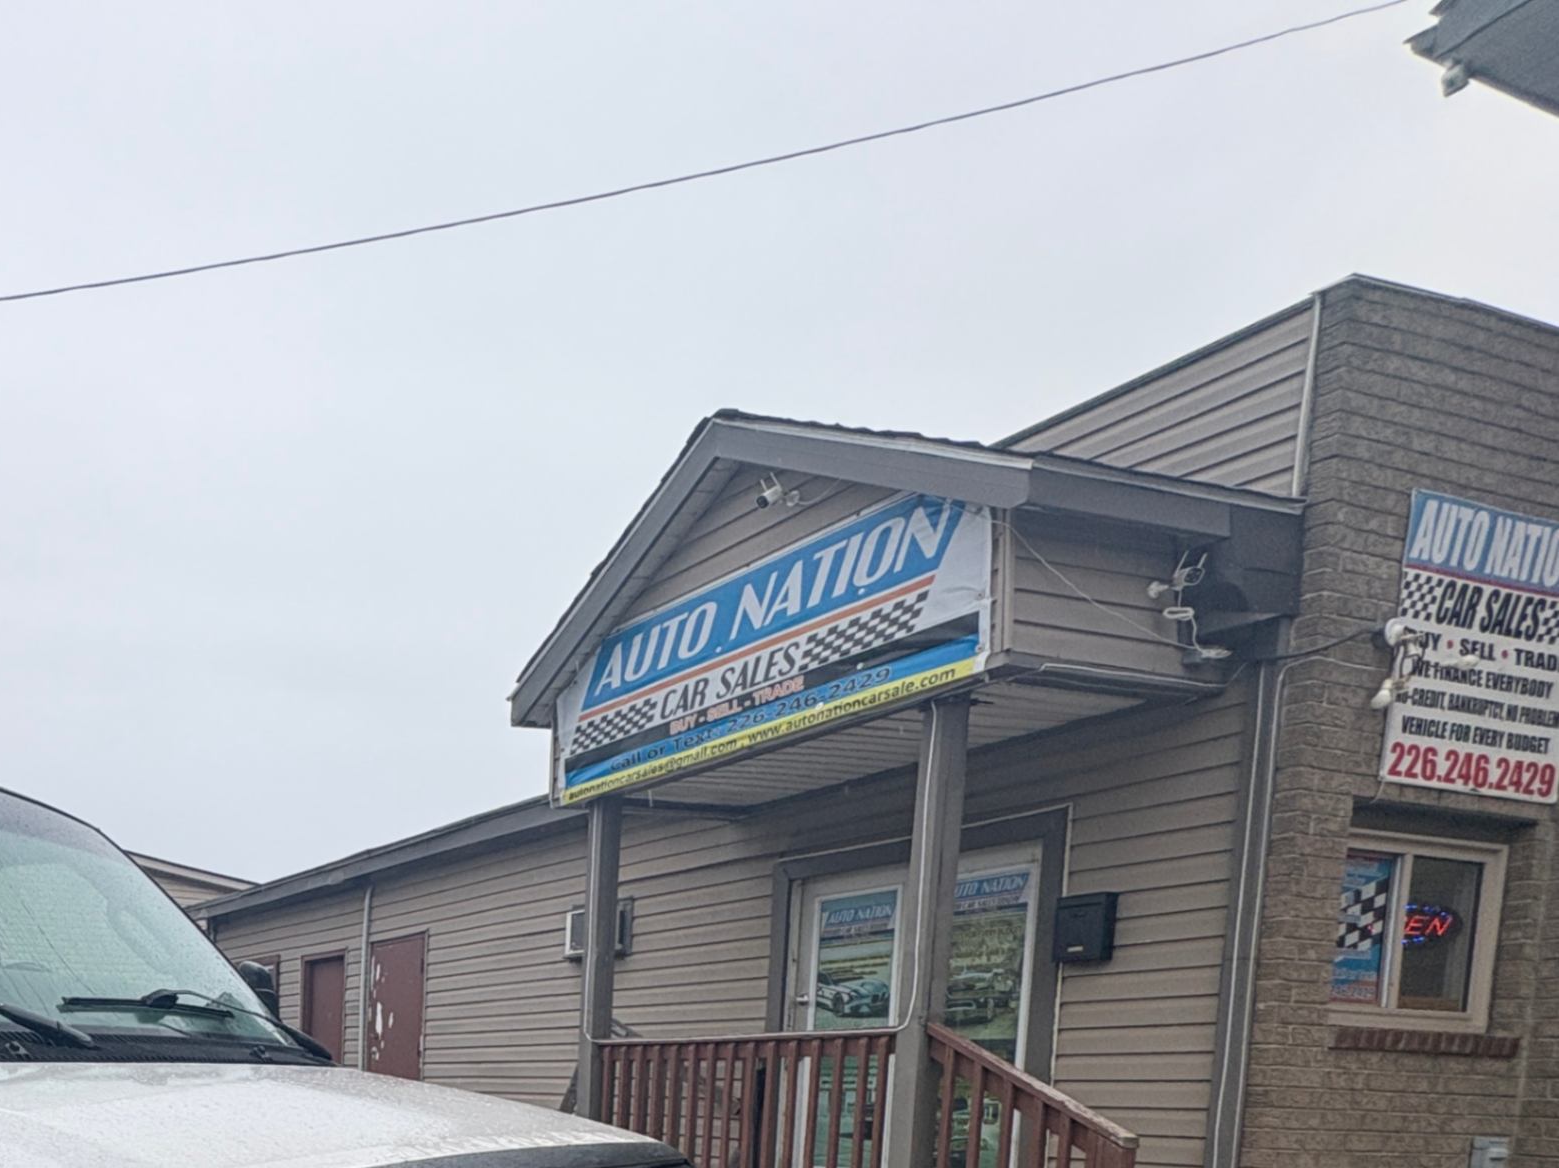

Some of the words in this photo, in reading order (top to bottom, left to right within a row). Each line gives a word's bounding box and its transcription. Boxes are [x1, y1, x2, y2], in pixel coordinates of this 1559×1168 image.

[1409, 499, 1491, 572] AUTO
[1484, 515, 1559, 588] NATIO
[594, 601, 718, 697] AUTO
[730, 498, 951, 641] NATION
[1435, 580, 1484, 630] CAR
[1479, 588, 1546, 641] SALES
[660, 676, 709, 720] CAR
[716, 641, 800, 700] SALES
[1434, 662, 1483, 688] FINANCE
[1485, 670, 1554, 699] EVERYBODY
[1459, 638, 1496, 662] SELL
[1513, 648, 1559, 673] TRAD
[610, 751, 641, 771] Call
[647, 745, 666, 760] or
[727, 668, 890, 733] 226-246-2429
[670, 713, 698, 736] BUY
[707, 699, 743, 722] SELL
[752, 675, 805, 706] TRADE
[747, 667, 956, 744] www.autonationcarsale.com
[1401, 715, 1448, 740] VEHICLE
[1449, 723, 1471, 742] FOR
[1472, 726, 1505, 748] EVERY
[1506, 732, 1551, 755] BUDGET
[1387, 741, 1556, 798] 226.246.2429
[954, 881, 978, 898] UTO
